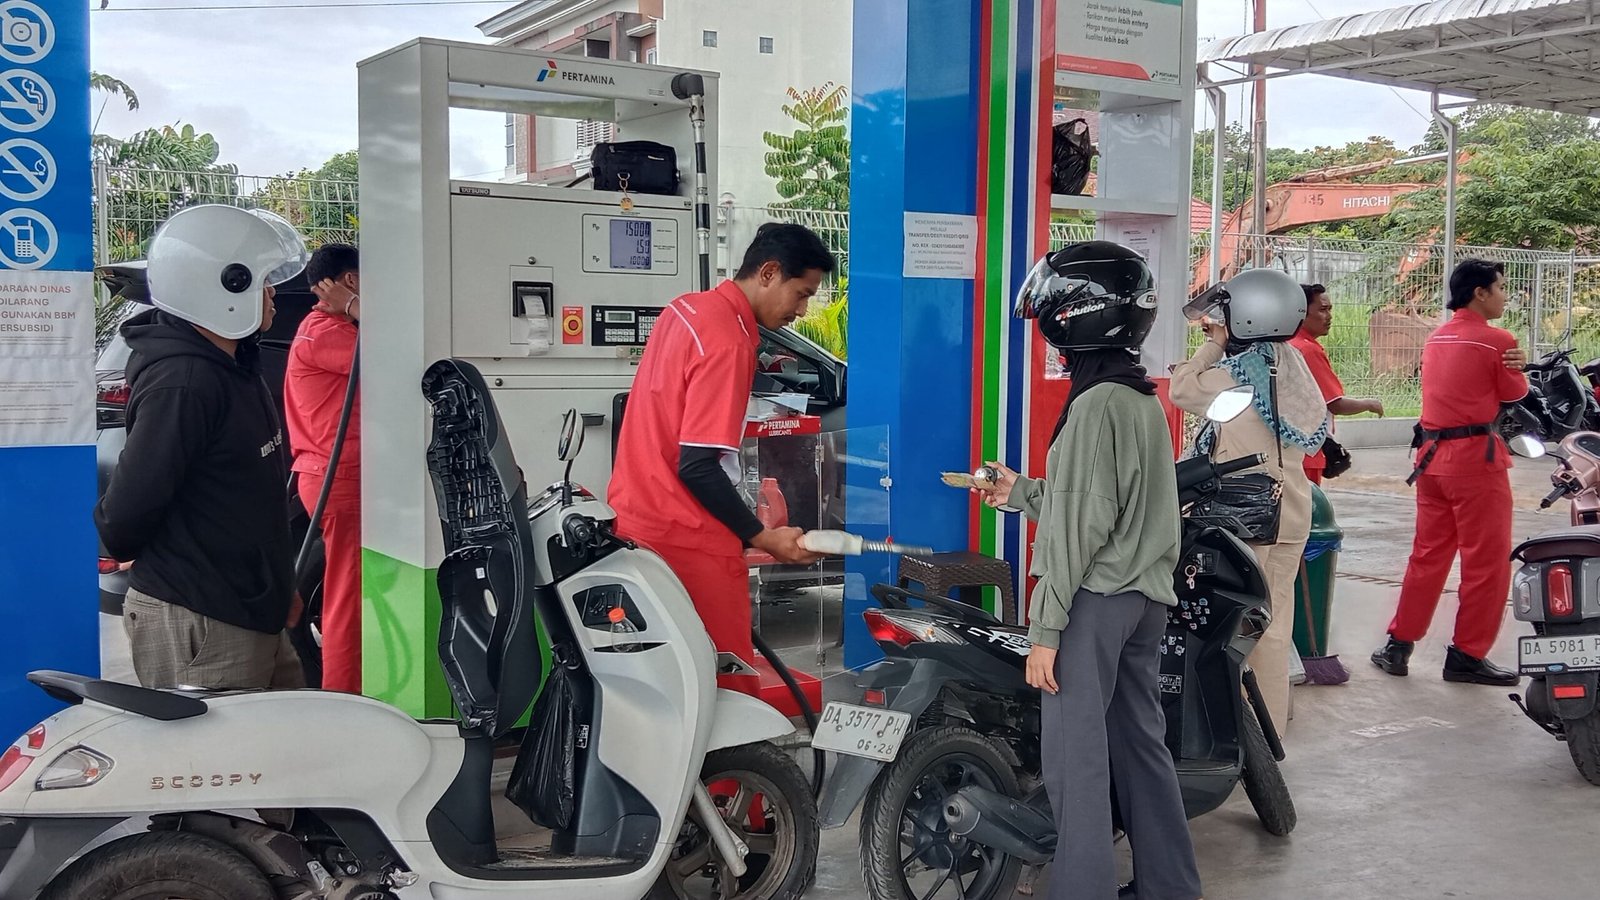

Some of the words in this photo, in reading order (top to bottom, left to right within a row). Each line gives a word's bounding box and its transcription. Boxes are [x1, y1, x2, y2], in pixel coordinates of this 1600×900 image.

[1117, 5, 1131, 15] lebih
[1131, 8, 1143, 17] jauh
[1117, 16, 1131, 25] lebih
[1131, 20, 1149, 30] enteng
[1103, 35, 1117, 43] lebih
[1117, 37, 1129, 45] baik
[562, 71, 616, 86] PERTAMINA
[1343, 195, 1390, 208] HITACHI
[40, 285, 72, 294] DINAS
[54, 311, 76, 320] BBM
[768, 420, 800, 430] PERTAMINA
[1524, 641, 1542, 655] DA
[1549, 639, 1585, 654] 5981
[823, 705, 842, 725] DA
[845, 710, 882, 730] 3577
[150, 772, 262, 790] SCOOPY
